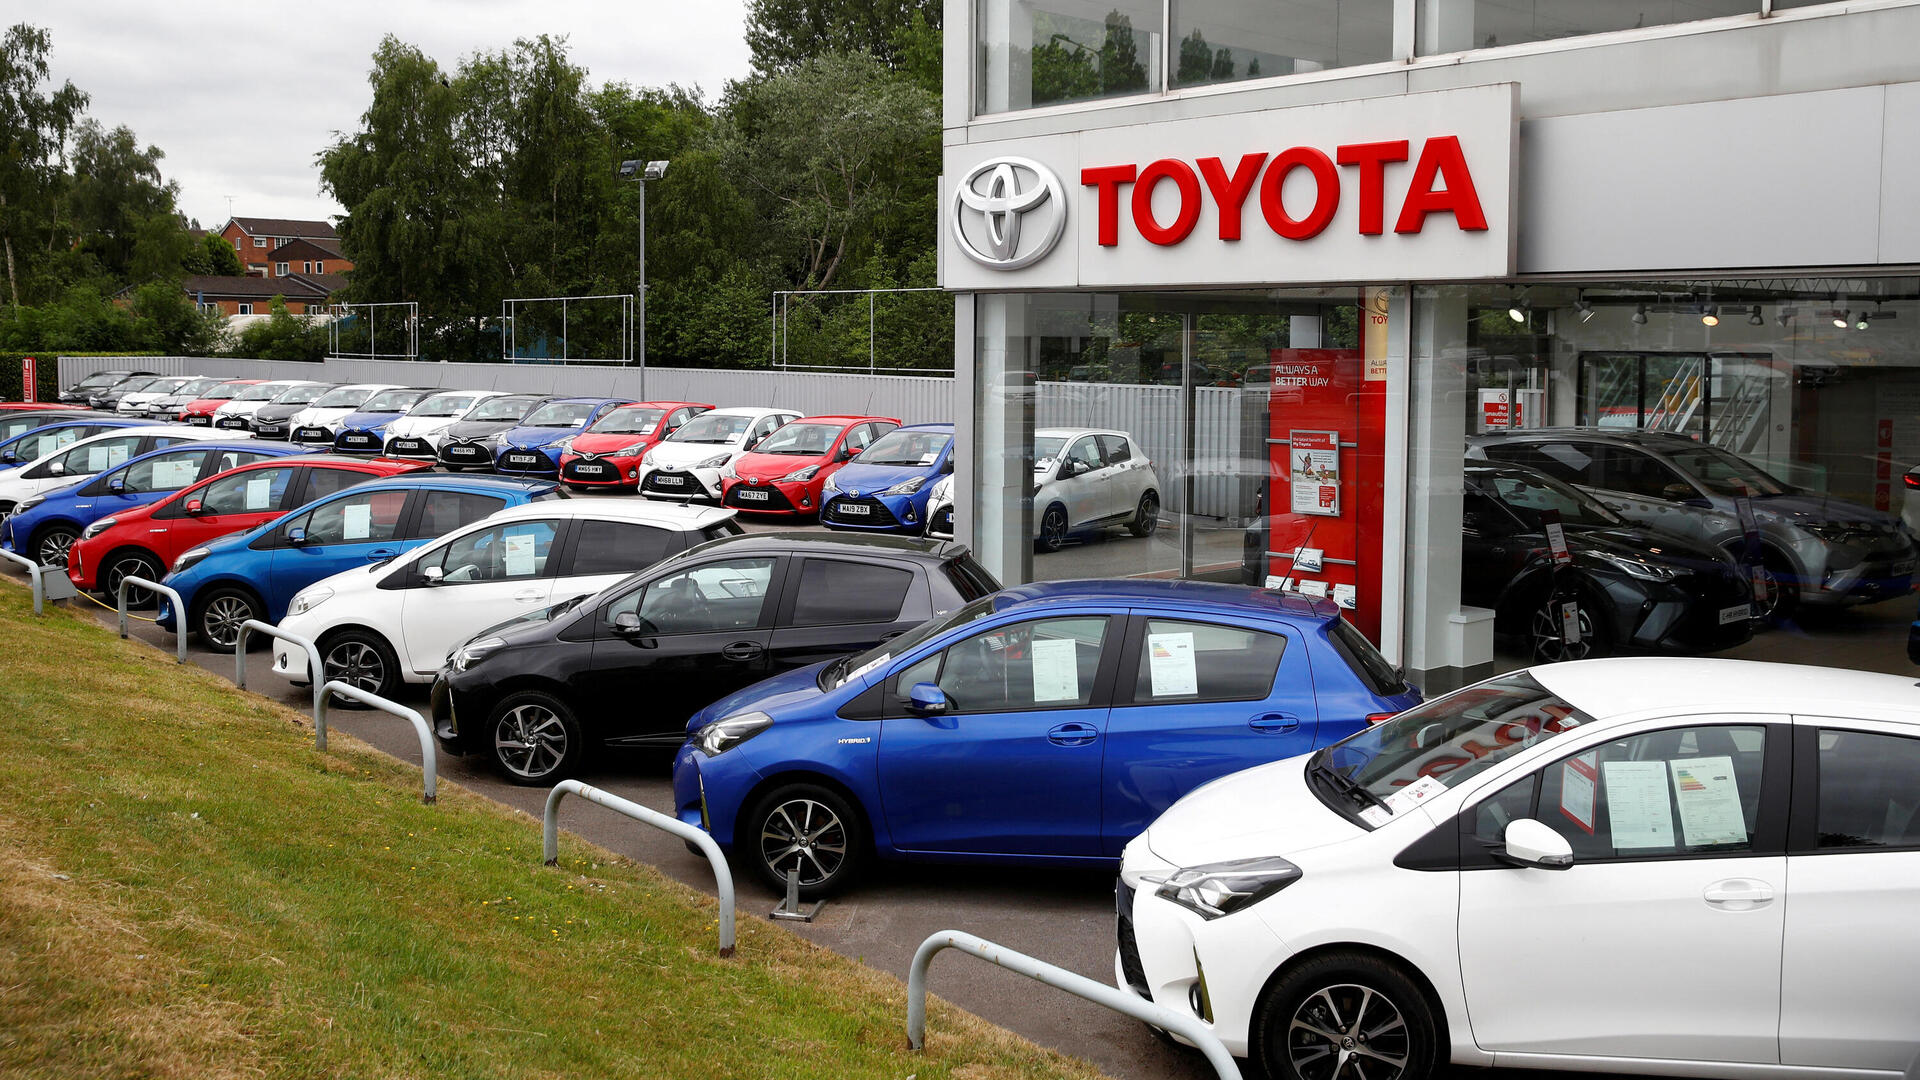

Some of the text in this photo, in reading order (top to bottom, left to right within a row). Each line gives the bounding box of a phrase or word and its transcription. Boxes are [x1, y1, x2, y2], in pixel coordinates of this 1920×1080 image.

[1081, 135, 1489, 247] TOYOTA
[1275, 365, 1318, 375] ALWAYS A
[1275, 377, 1329, 387] BETTER WAY
[842, 505, 868, 514] MA19 ZBX
